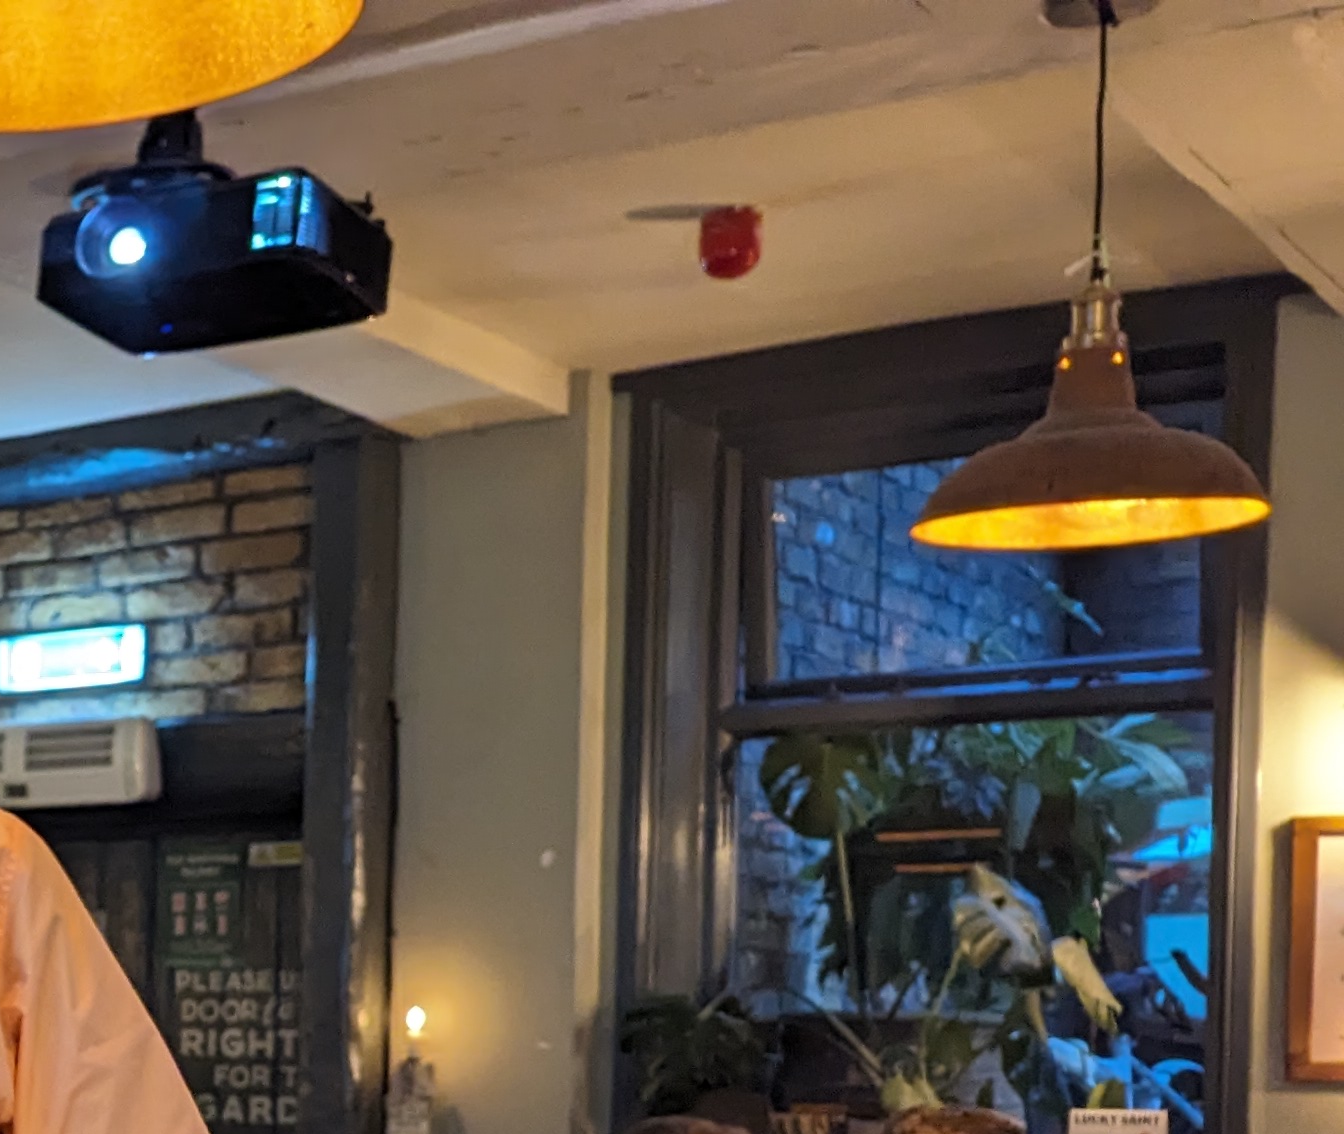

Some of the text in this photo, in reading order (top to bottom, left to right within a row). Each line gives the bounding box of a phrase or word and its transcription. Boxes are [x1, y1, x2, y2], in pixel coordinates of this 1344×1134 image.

[175, 969, 274, 993] PLEASE
[179, 1027, 299, 1059] RIGHT
[213, 1064, 271, 1089] FOR
